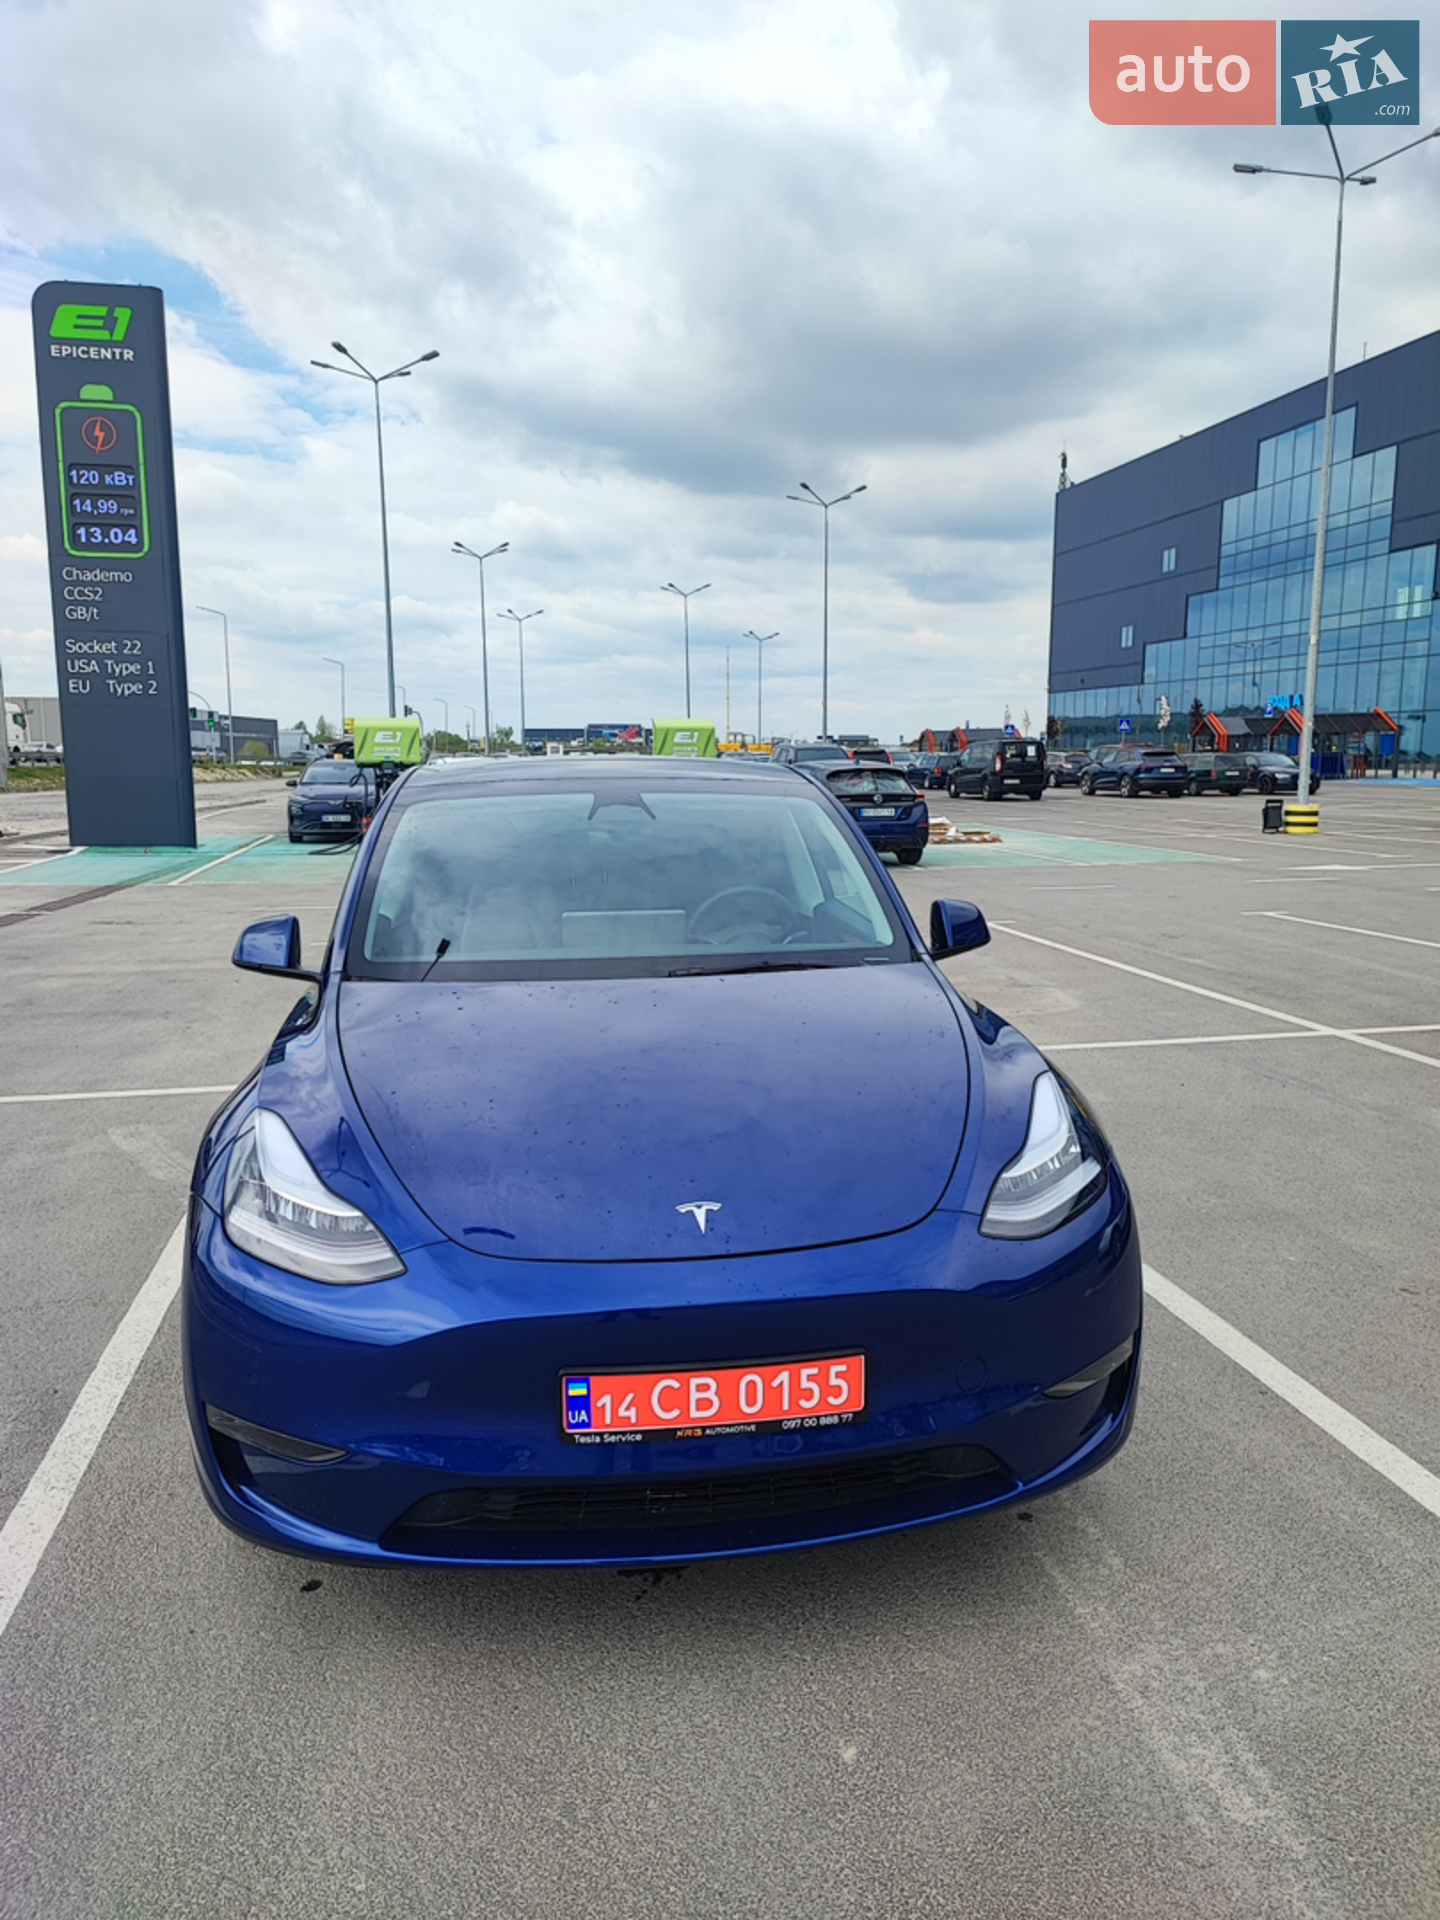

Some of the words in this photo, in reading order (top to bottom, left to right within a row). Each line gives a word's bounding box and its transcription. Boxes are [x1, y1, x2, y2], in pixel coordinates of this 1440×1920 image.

[50, 345, 135, 361] EPICENTR
[69, 468, 100, 485] 120
[72, 498, 119, 516] 14,99
[76, 526, 139, 545] 13.04
[62, 567, 133, 583] Chademo
[63, 586, 103, 601] CCS2
[65, 606, 100, 622] GB/t
[65, 639, 118, 654] Socket
[122, 640, 142, 655] 22
[66, 659, 100, 674] USA
[104, 660, 141, 677] Type
[147, 661, 155, 675] 1
[68, 679, 90, 694] EU
[106, 680, 143, 697] Type
[148, 681, 158, 695] 2
[568, 1410, 589, 1424] UA
[596, 1393, 637, 1426] 14
[650, 1377, 721, 1420] CB
[738, 1364, 849, 1415] 0155
[782, 1418, 802, 1430] 097
[841, 1413, 854, 1423] 77
[573, 1434, 601, 1444] Tesla
[603, 1432, 643, 1443] Service
[704, 1424, 757, 1436] AUTOMOTIVE
